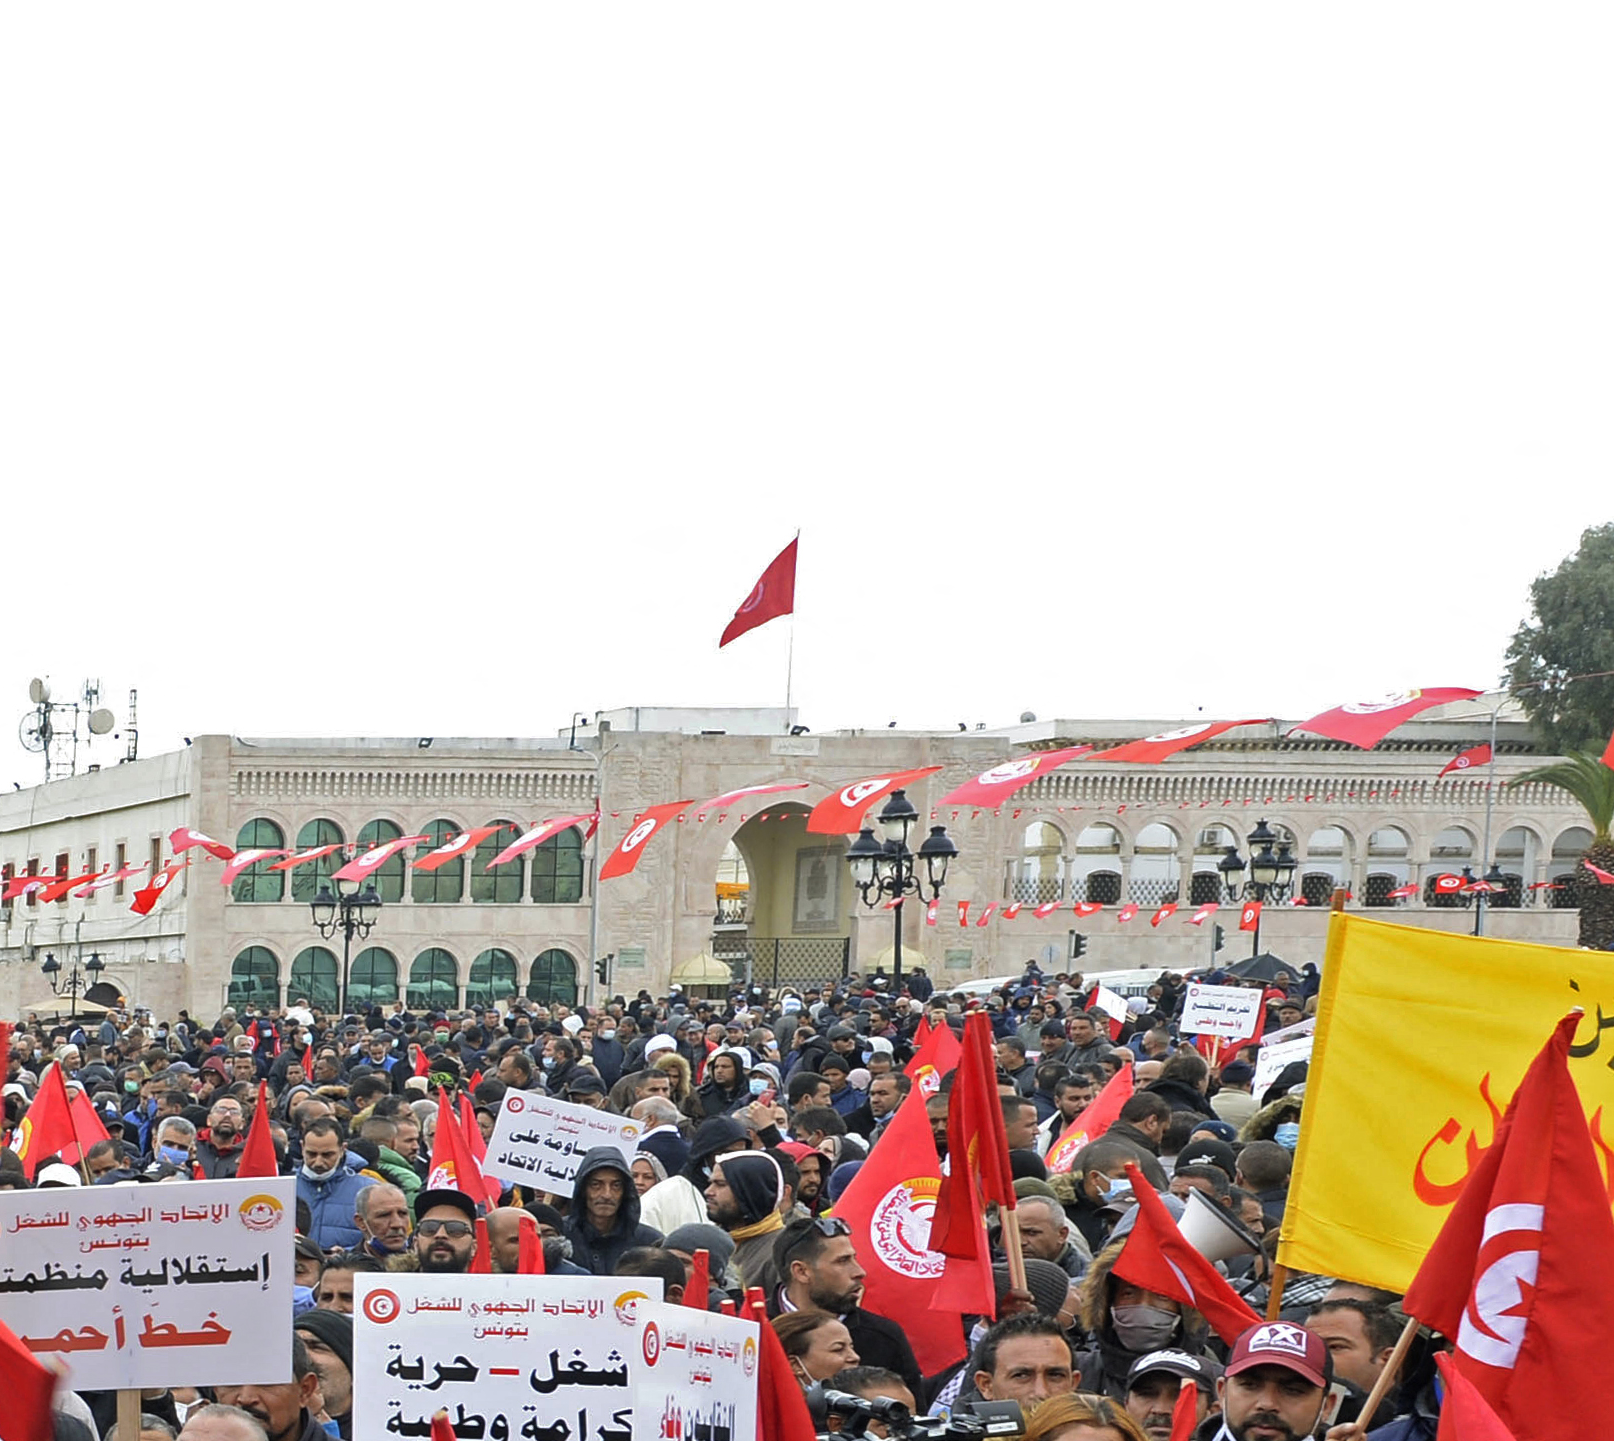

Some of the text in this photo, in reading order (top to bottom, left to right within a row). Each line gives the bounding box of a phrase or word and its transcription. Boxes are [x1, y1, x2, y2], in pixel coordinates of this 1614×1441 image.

[119, 1251, 270, 1294] إستقلالية
[20, 1304, 127, 1354] أحم
[384, 1342, 629, 1394] شغل حرية
